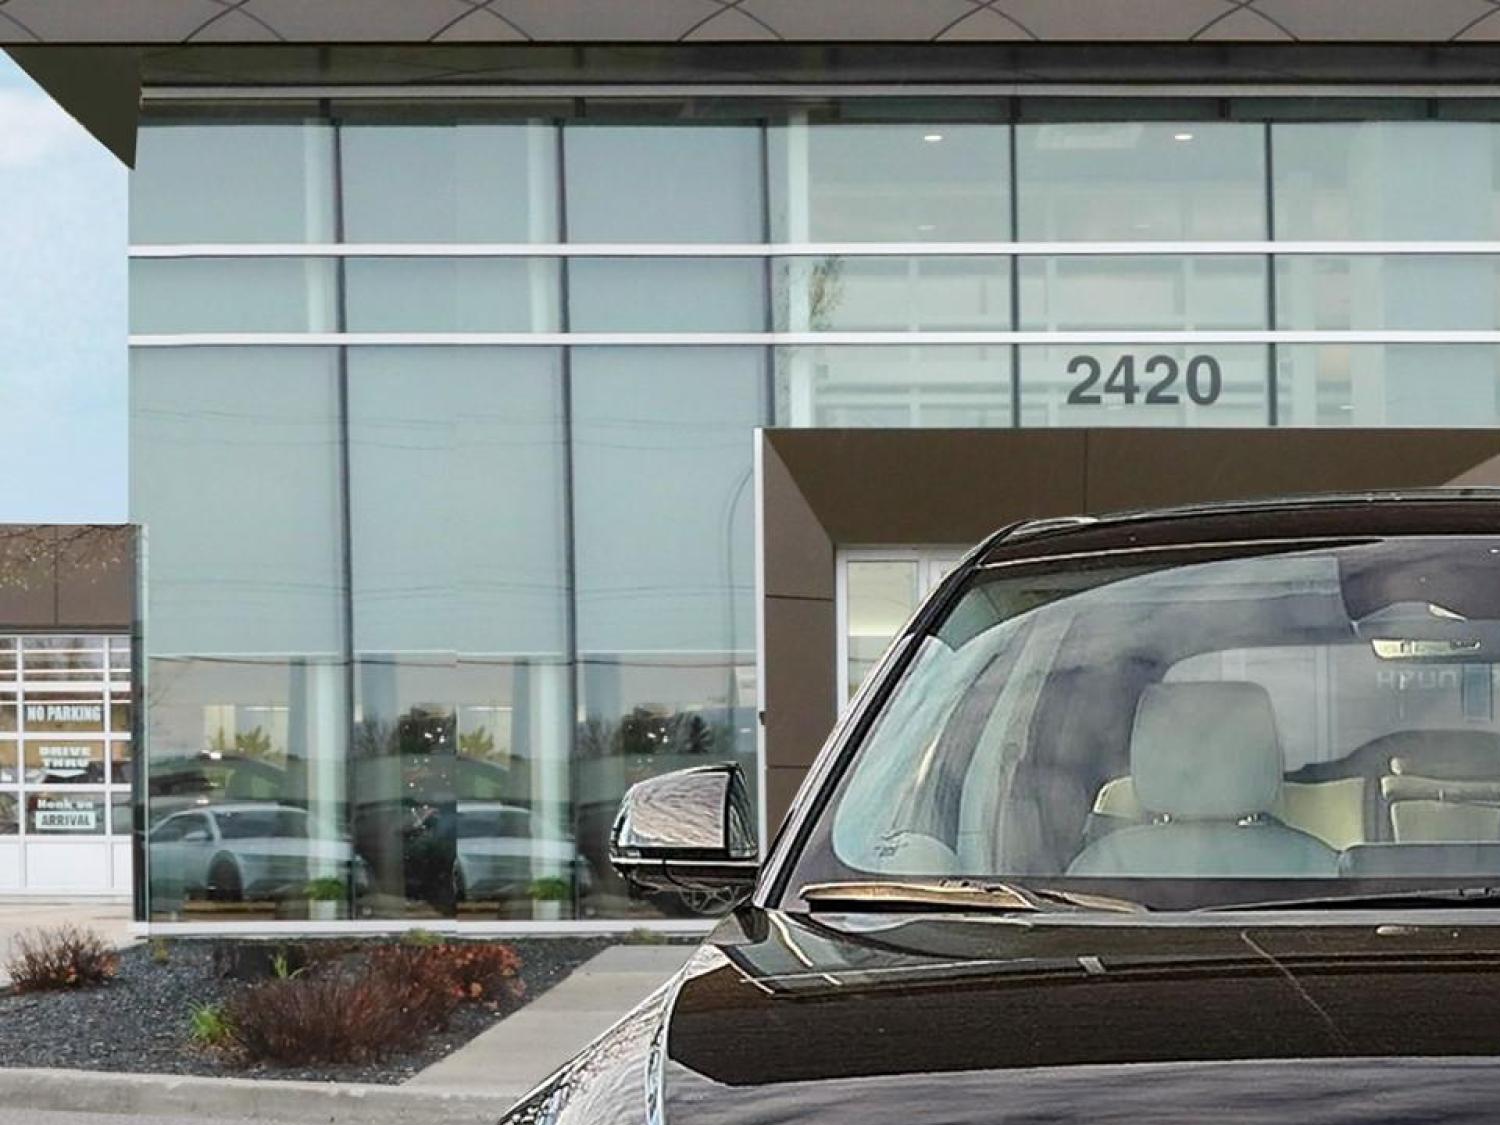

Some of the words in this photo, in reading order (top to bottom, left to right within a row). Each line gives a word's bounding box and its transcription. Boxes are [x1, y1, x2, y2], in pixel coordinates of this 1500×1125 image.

[1066, 354, 1222, 406] 2420
[27, 705, 45, 721] NO
[47, 705, 101, 721] PARKING
[38, 746, 91, 757] DRIVE
[41, 814, 91, 826] ARRIVAL
